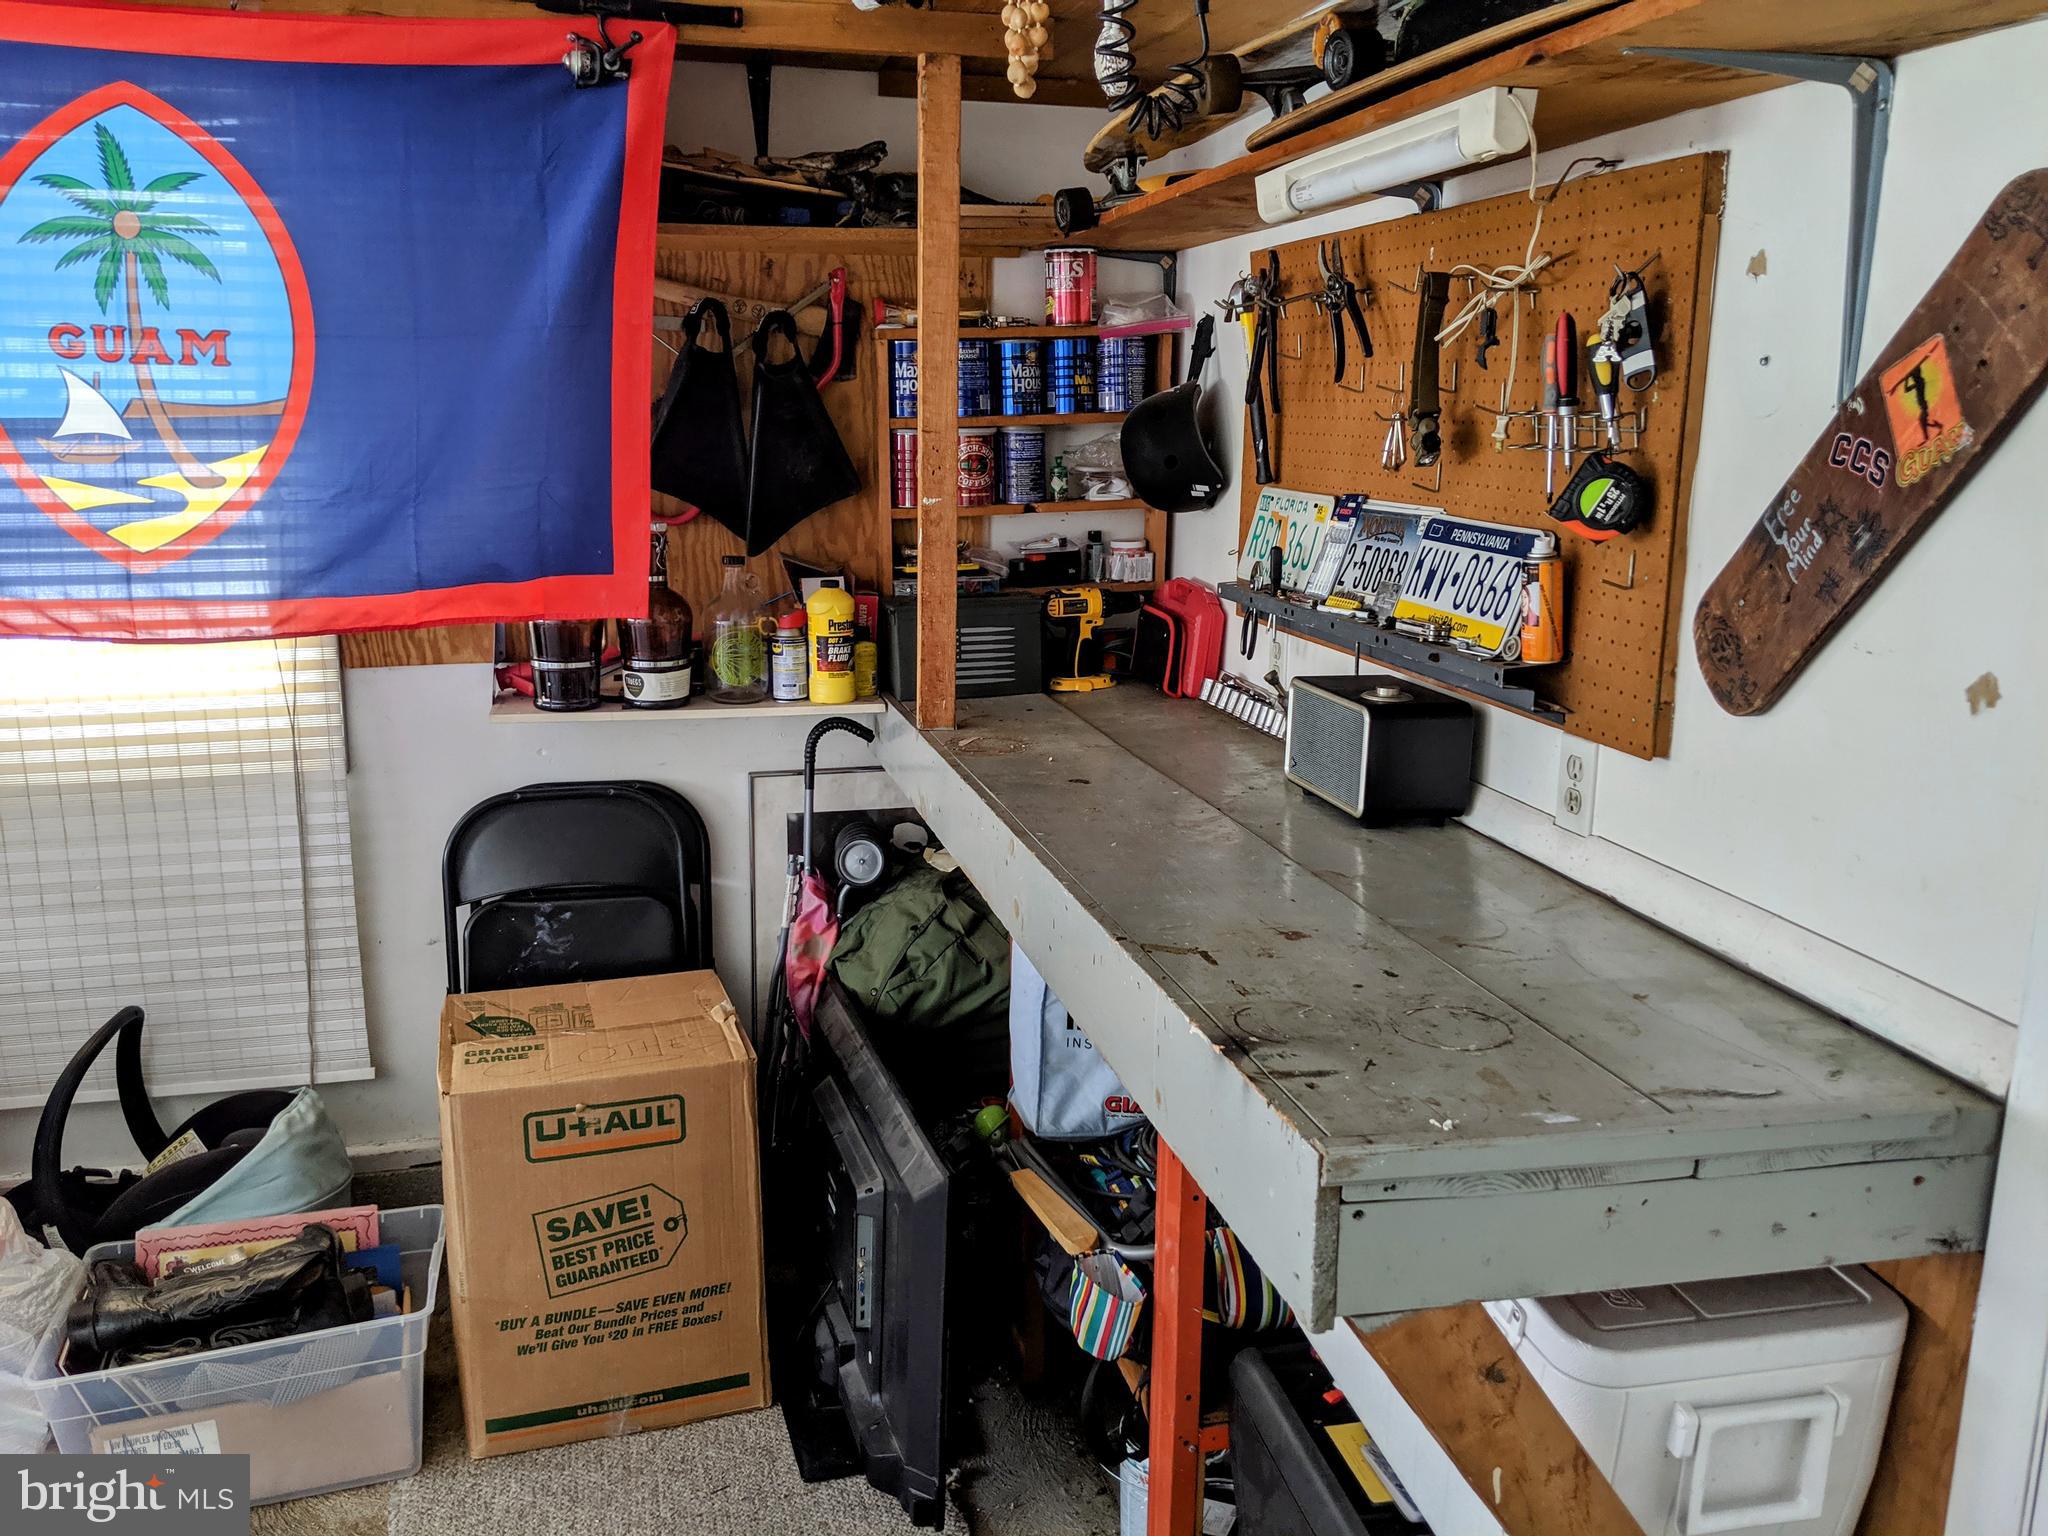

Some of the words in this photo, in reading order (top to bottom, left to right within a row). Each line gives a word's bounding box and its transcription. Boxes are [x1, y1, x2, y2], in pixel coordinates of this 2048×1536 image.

[48, 322, 232, 367] GUAM
[1829, 432, 1890, 489] CCS
[1274, 497, 1309, 514] FLORIDA
[1763, 488, 1802, 545] Free
[1450, 528, 1511, 551] PENNSYLVANIA
[1779, 516, 1812, 559] Your
[1786, 529, 1824, 584] Mind
[827, 653, 849, 662] FLUID
[828, 645, 852, 655] BRAKE
[464, 1043, 545, 1058] GRANDE
[464, 1052, 530, 1065] LARGE
[546, 1194, 652, 1242] SAVE!
[183, 1259, 225, 1274] WELCOME
[551, 1246, 598, 1271] BEST
[602, 1230, 656, 1257] PRICE
[530, 1316, 540, 1327] A
[652, 1291, 686, 1308] EVEN
[689, 1282, 732, 1300] MORE!
[535, 1326, 564, 1340] Beat
[568, 1322, 589, 1335] Our
[593, 1315, 637, 1331] Bundle
[640, 1307, 678, 1323] Prices
[681, 1302, 705, 1315] and
[551, 1338, 578, 1351] Give
[582, 1334, 604, 1346] You
[608, 1328, 629, 1341] $20
[632, 1325, 644, 1337] in
[648, 1319, 679, 1335] FREE
[681, 1310, 723, 1328] Boxes!
